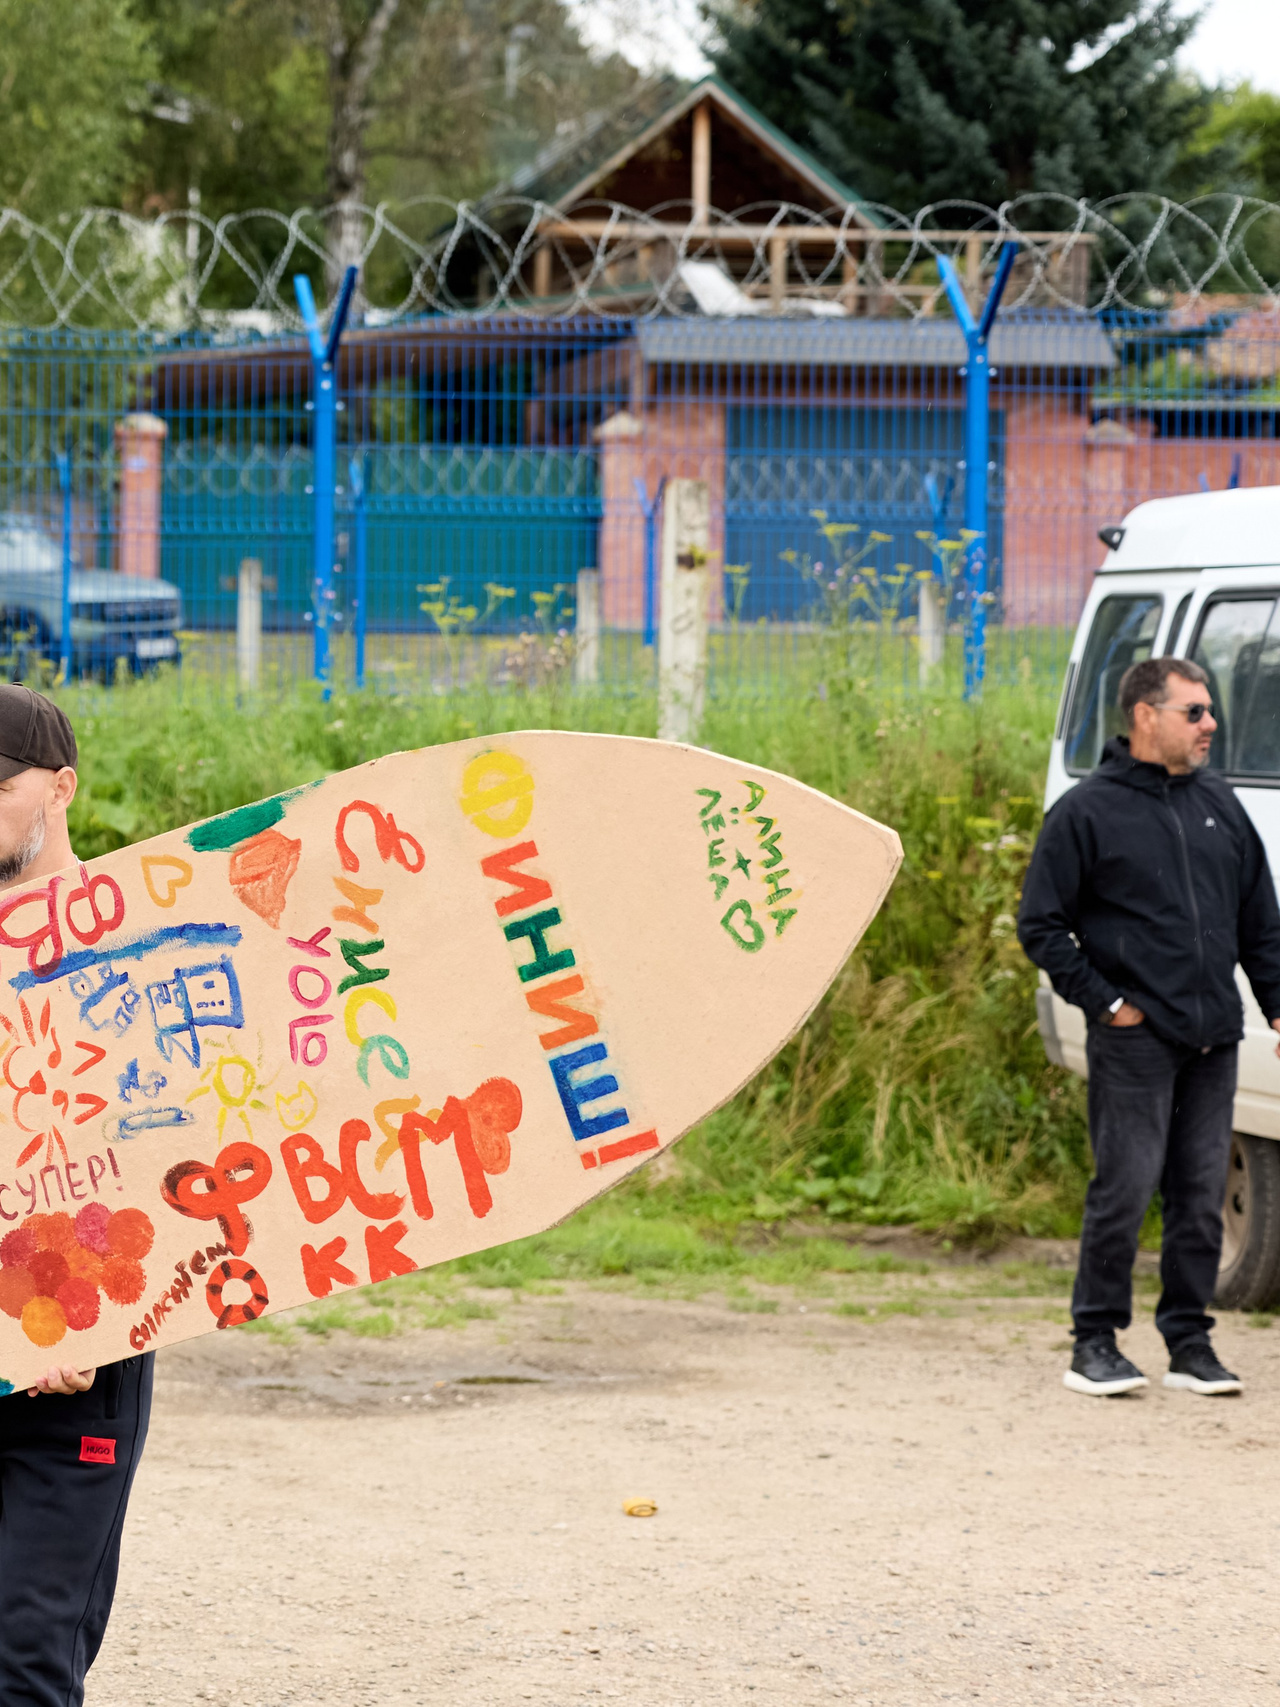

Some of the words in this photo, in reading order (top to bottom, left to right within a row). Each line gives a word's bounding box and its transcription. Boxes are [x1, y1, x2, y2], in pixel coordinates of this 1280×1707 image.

[738, 780, 798, 937] АЛИНА
[459, 749, 660, 1170] ФИНИШ!
[86, 1445, 110, 1455] HUGO
